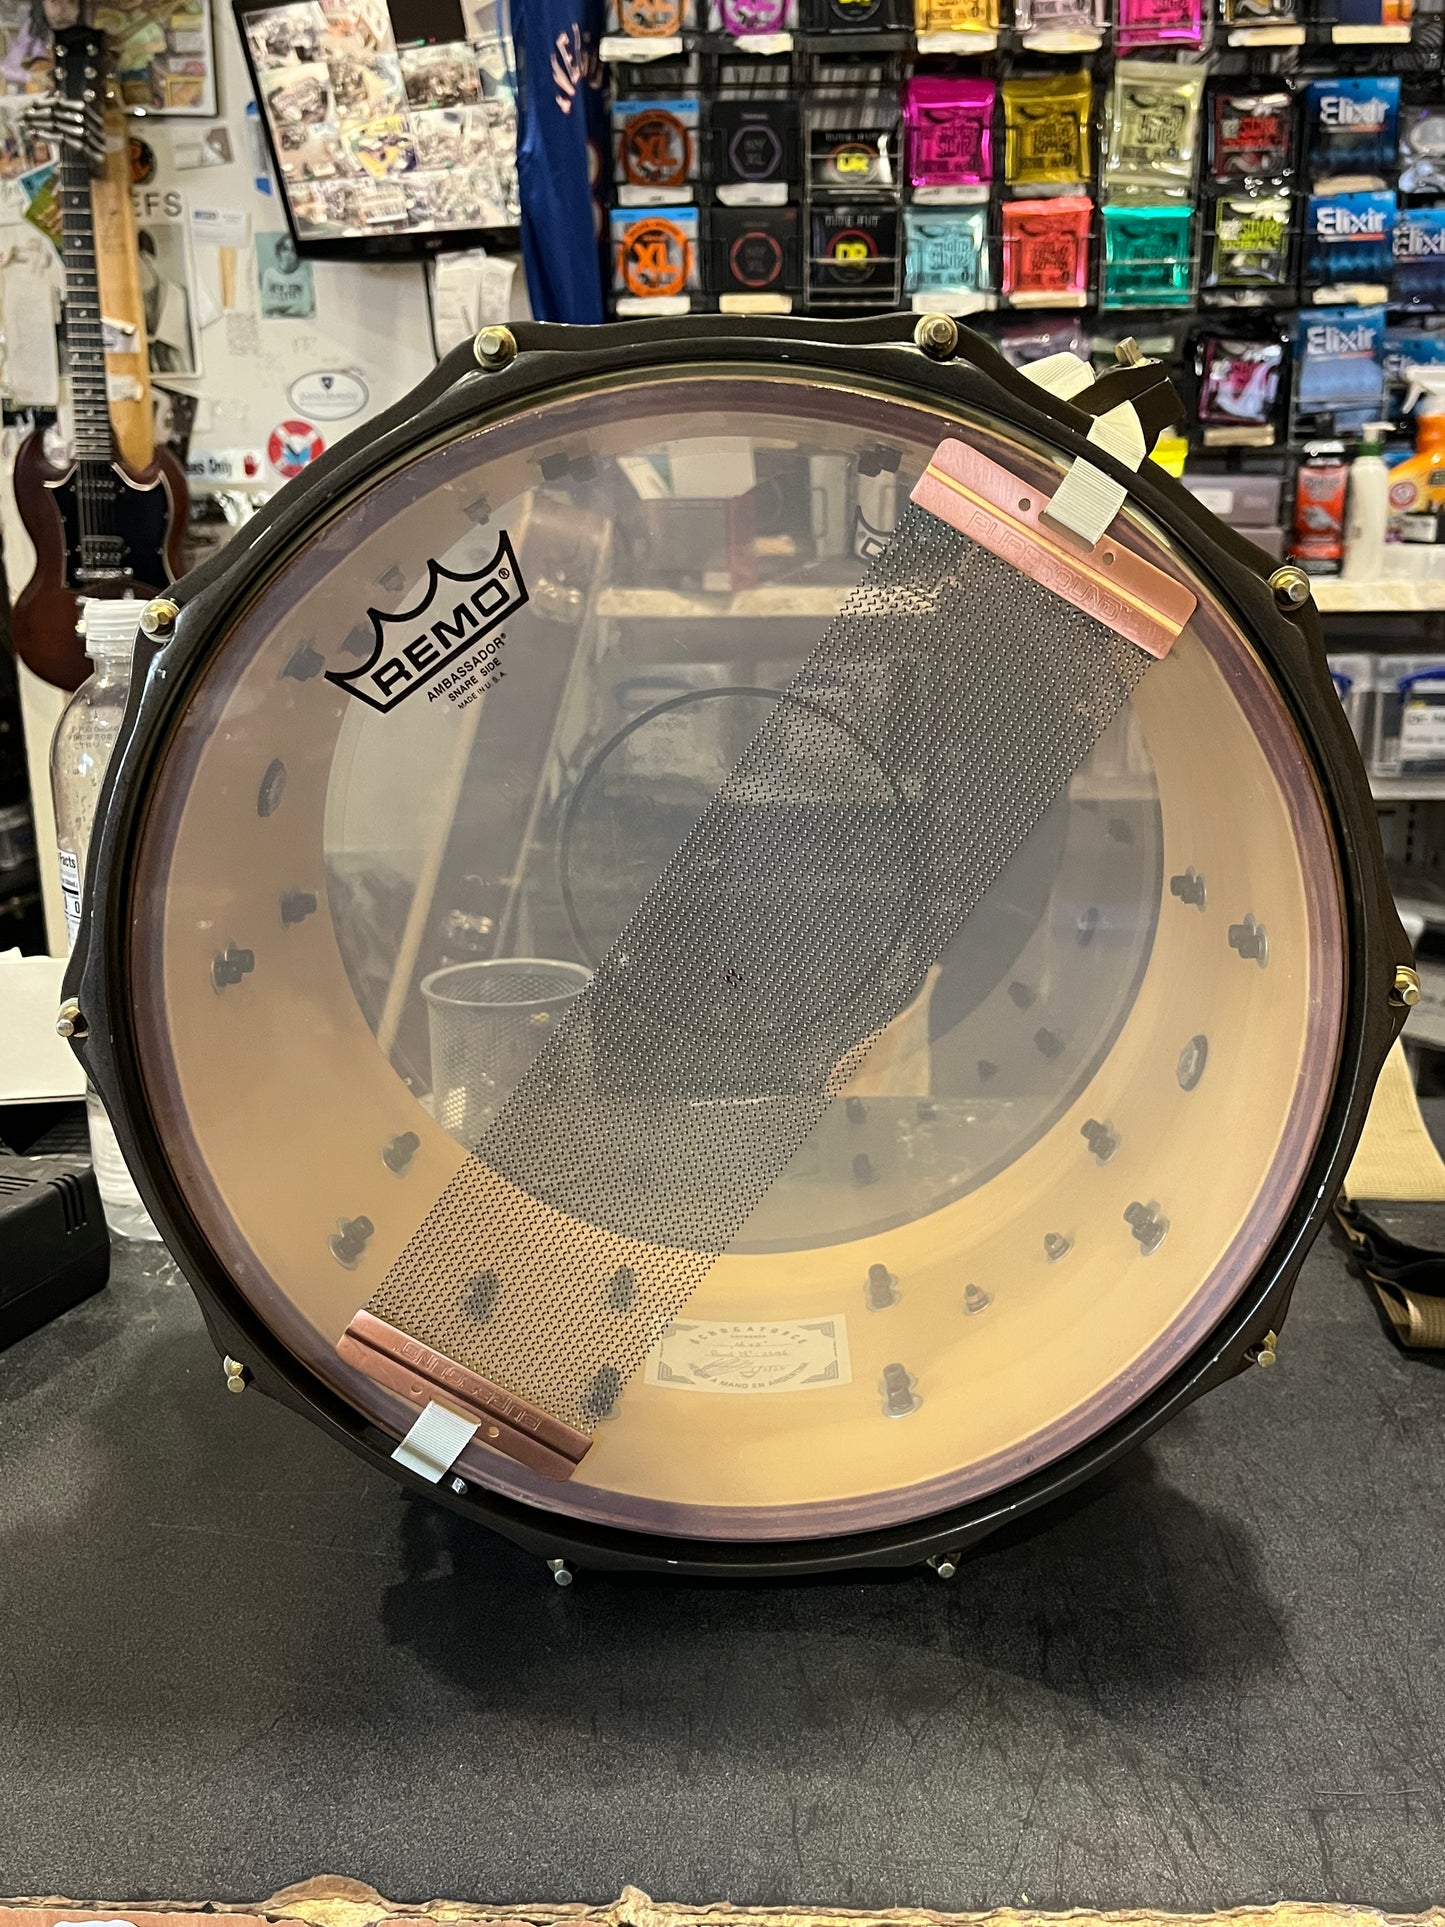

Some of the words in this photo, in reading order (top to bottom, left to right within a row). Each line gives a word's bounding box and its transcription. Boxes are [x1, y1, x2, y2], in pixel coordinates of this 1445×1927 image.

[1319, 96, 1390, 125] Elixir
[634, 134, 678, 167] XL
[1316, 207, 1387, 234] Elixir
[633, 242, 677, 273] XL
[1307, 325, 1377, 355] Elixir
[370, 577, 510, 698] REMO
[426, 634, 506, 703] AMBASSADOR
[447, 676, 479, 702] SNARE
[479, 657, 502, 678] SIDE
[457, 692, 478, 710] MADE
